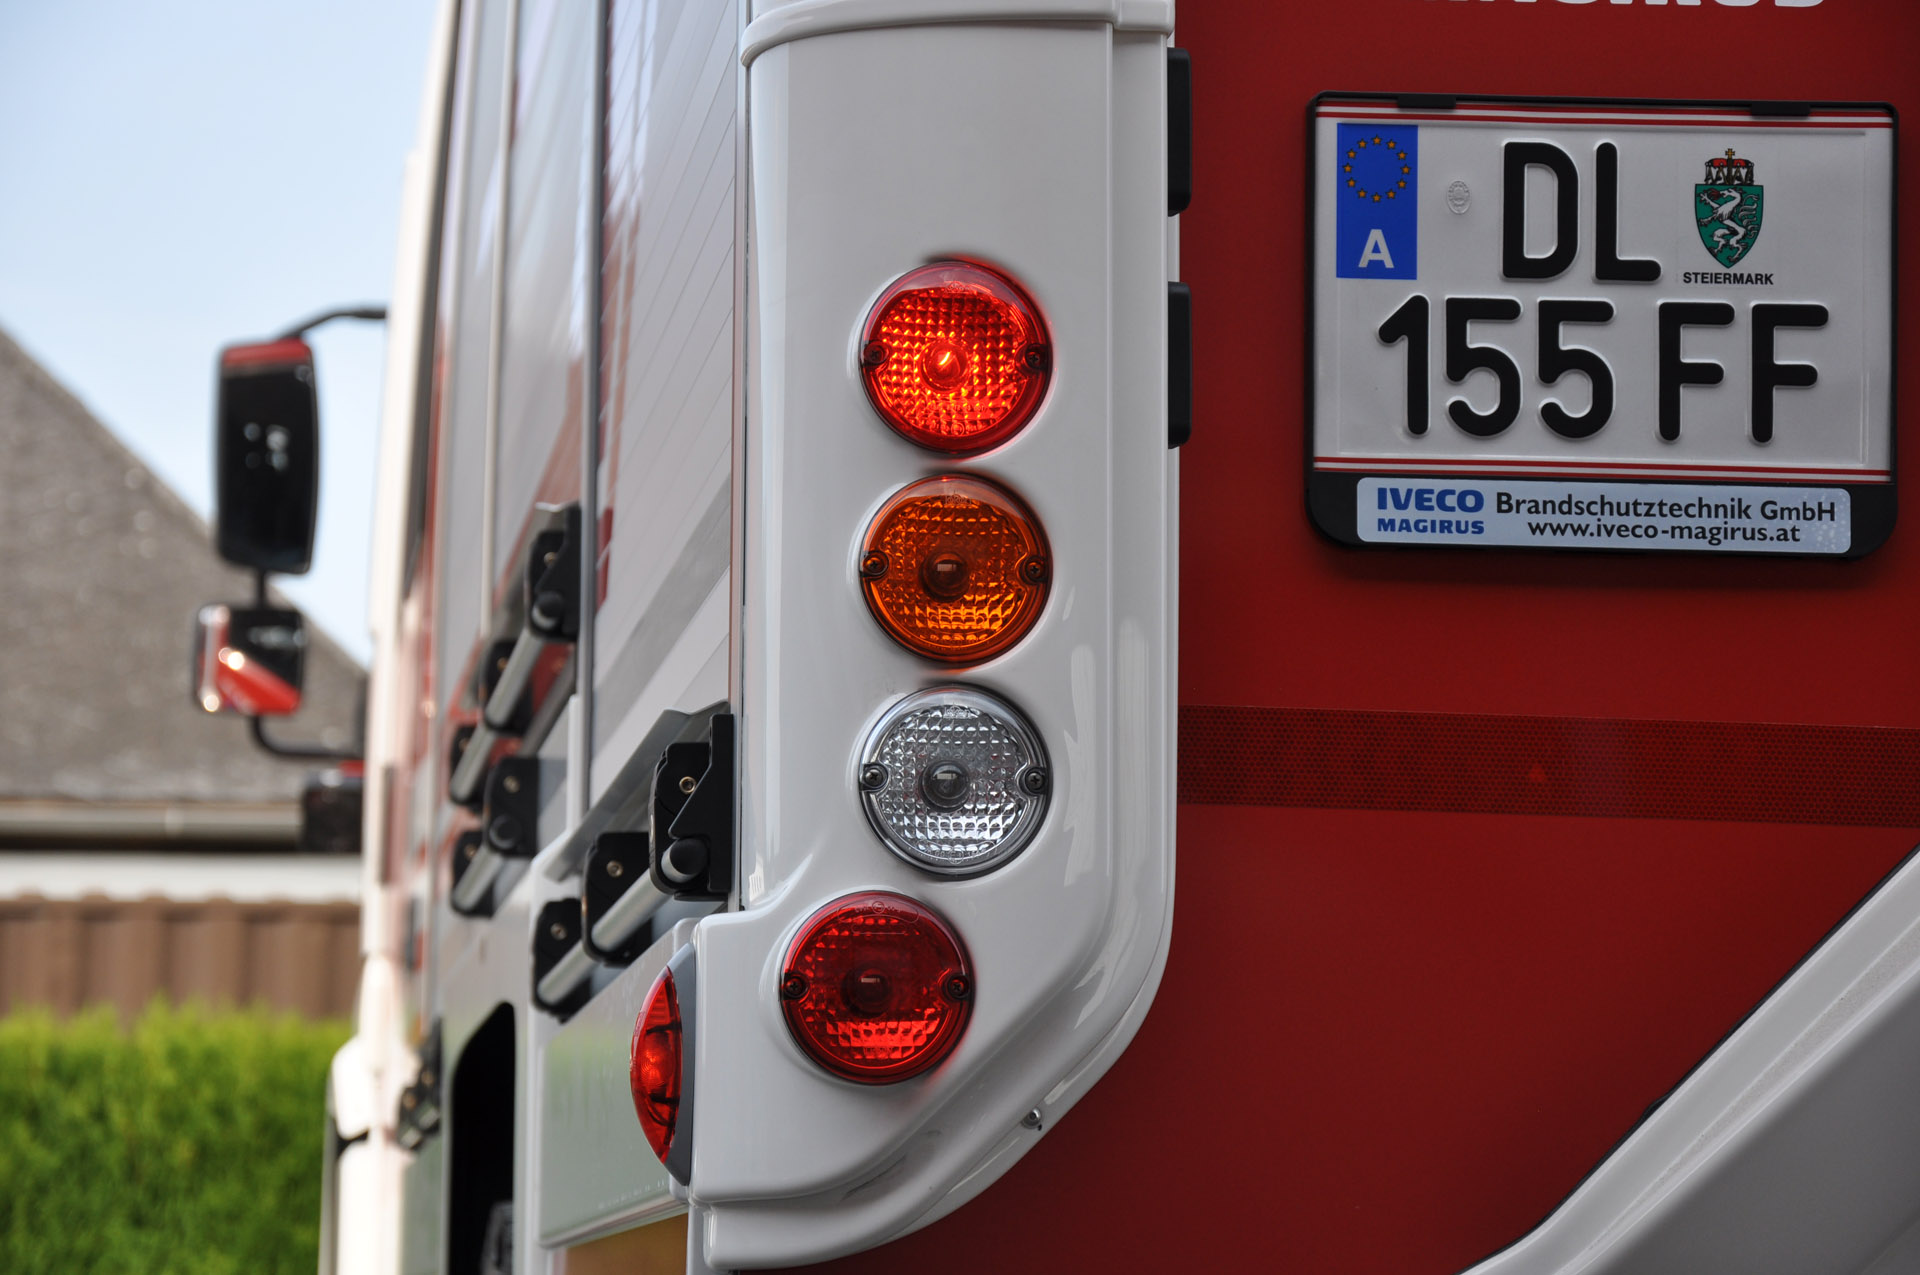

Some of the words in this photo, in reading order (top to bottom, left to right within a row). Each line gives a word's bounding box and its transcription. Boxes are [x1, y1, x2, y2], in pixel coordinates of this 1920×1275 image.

[1503, 141, 1662, 285] DL
[1358, 229, 1395, 268] A
[1683, 271, 1774, 286] STEIERMARK
[1378, 295, 1614, 440] 155
[1658, 302, 1829, 446] FF
[1377, 487, 1485, 513] IVECO
[1496, 492, 1753, 520] Brandschutztechnik
[1760, 500, 1836, 522] GmbH
[1377, 518, 1485, 535] MAGIRUS
[1528, 518, 1801, 546] www.iveco-magirus.at
